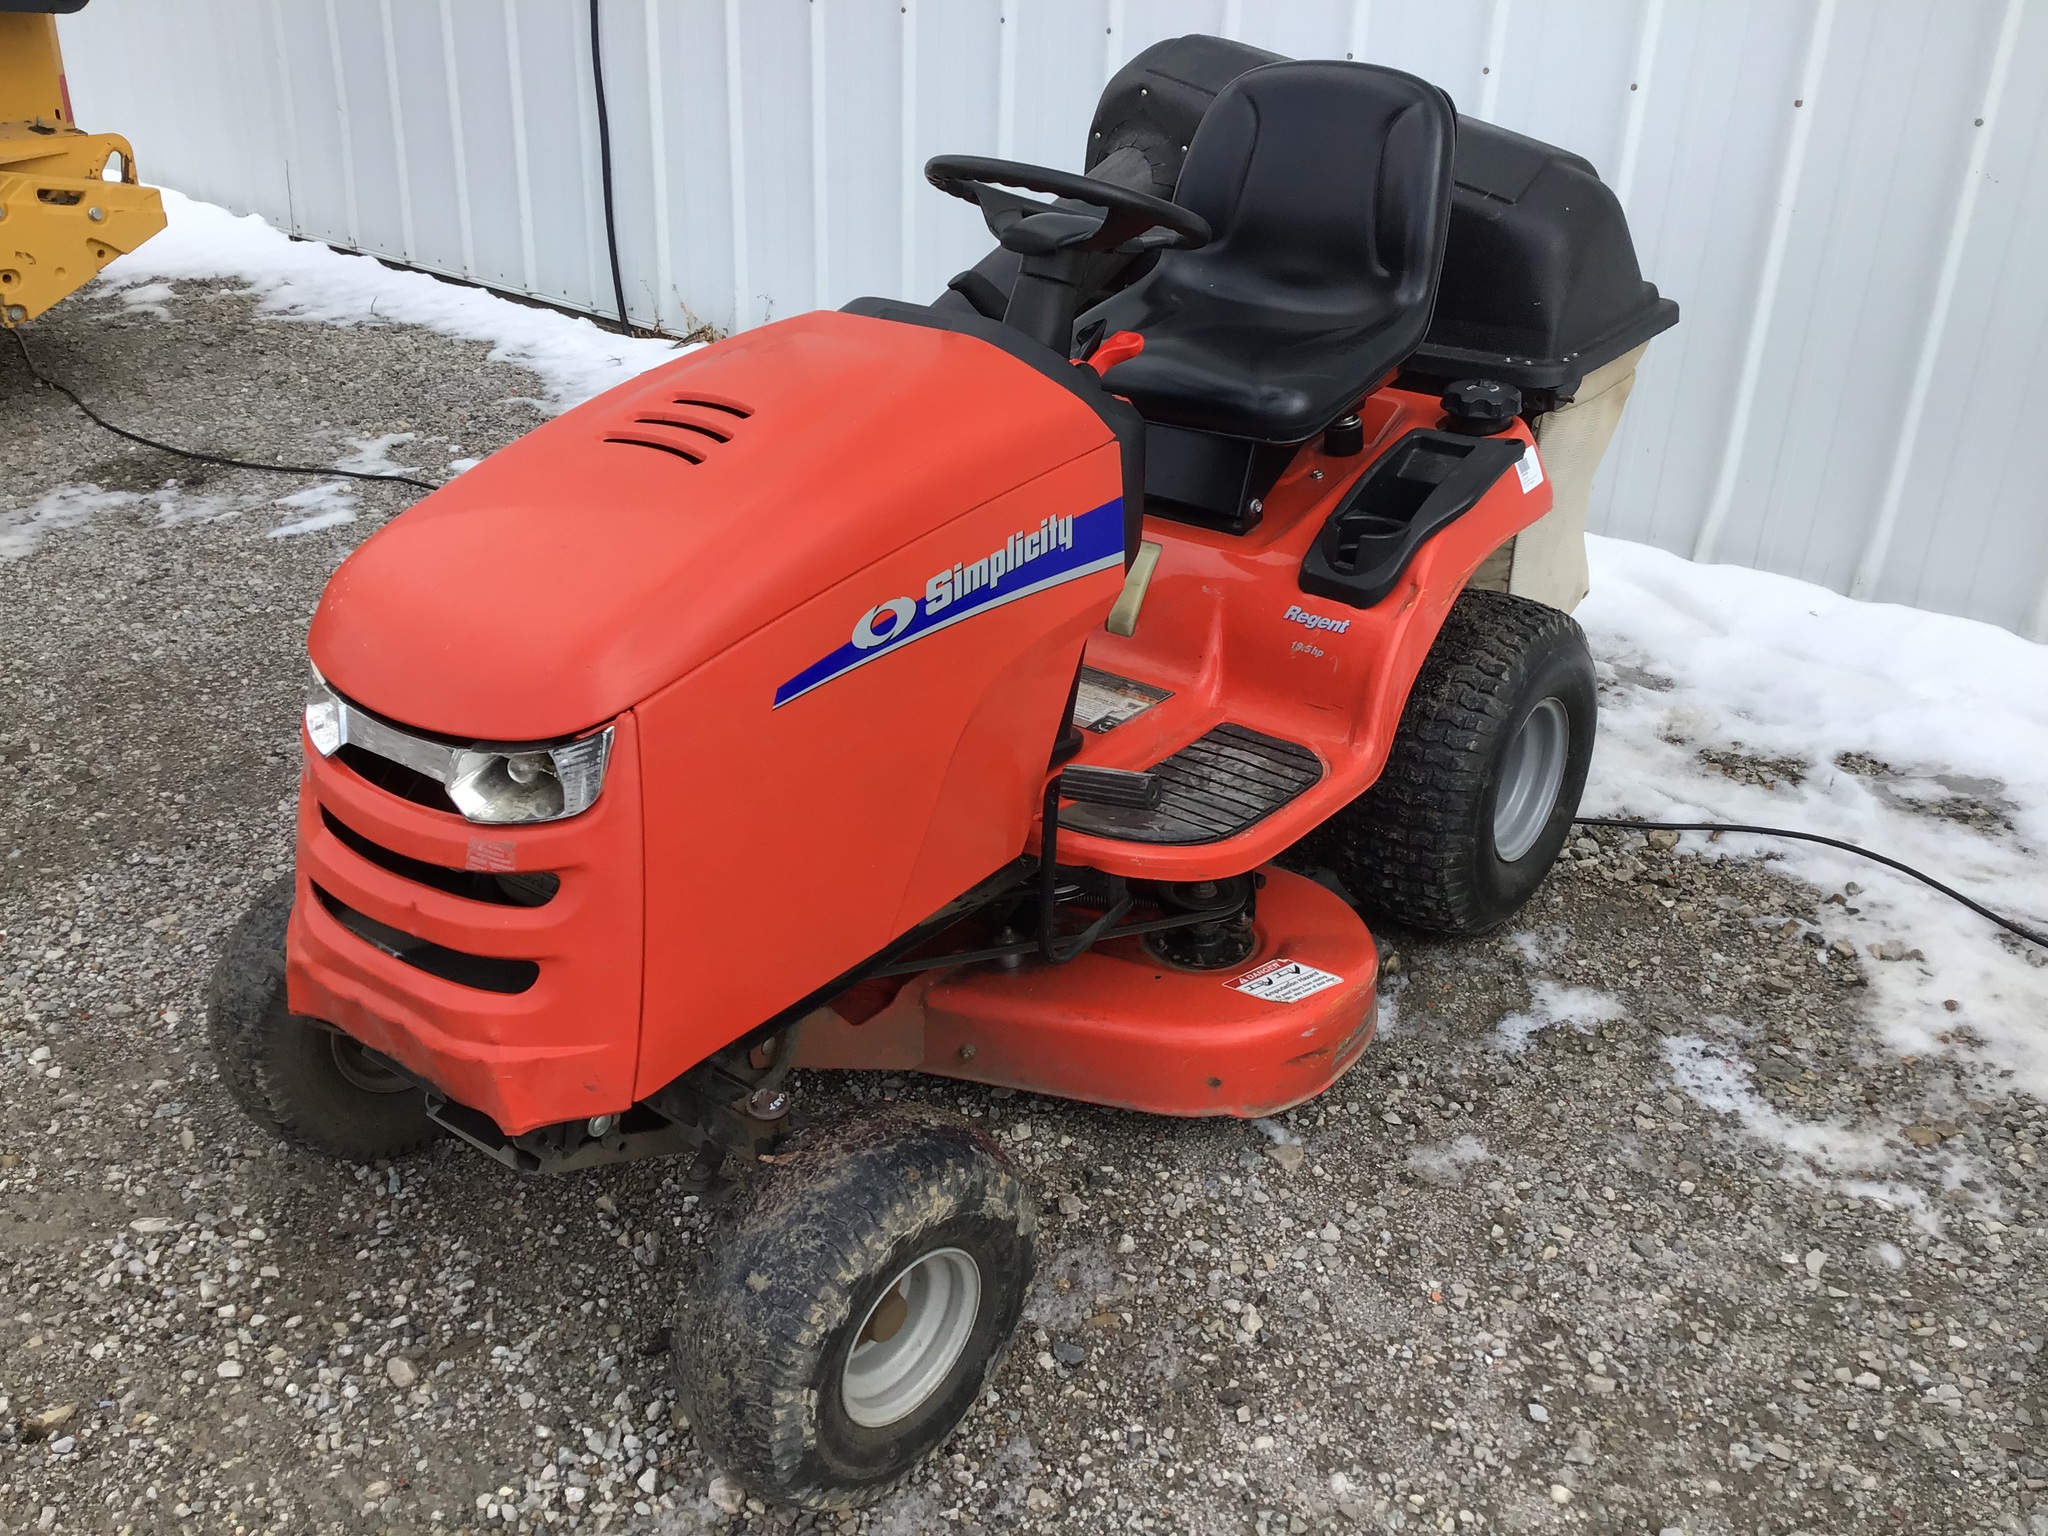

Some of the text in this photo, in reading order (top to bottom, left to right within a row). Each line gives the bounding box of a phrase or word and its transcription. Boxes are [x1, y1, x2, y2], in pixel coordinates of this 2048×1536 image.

[925, 513, 1073, 617] Simplicity
[1283, 605, 1350, 634] Regent
[1291, 641, 1325, 658] 19.5 hp
[1246, 962, 1281, 980] DANGER
[1264, 970, 1320, 997] Amputation Hazard
